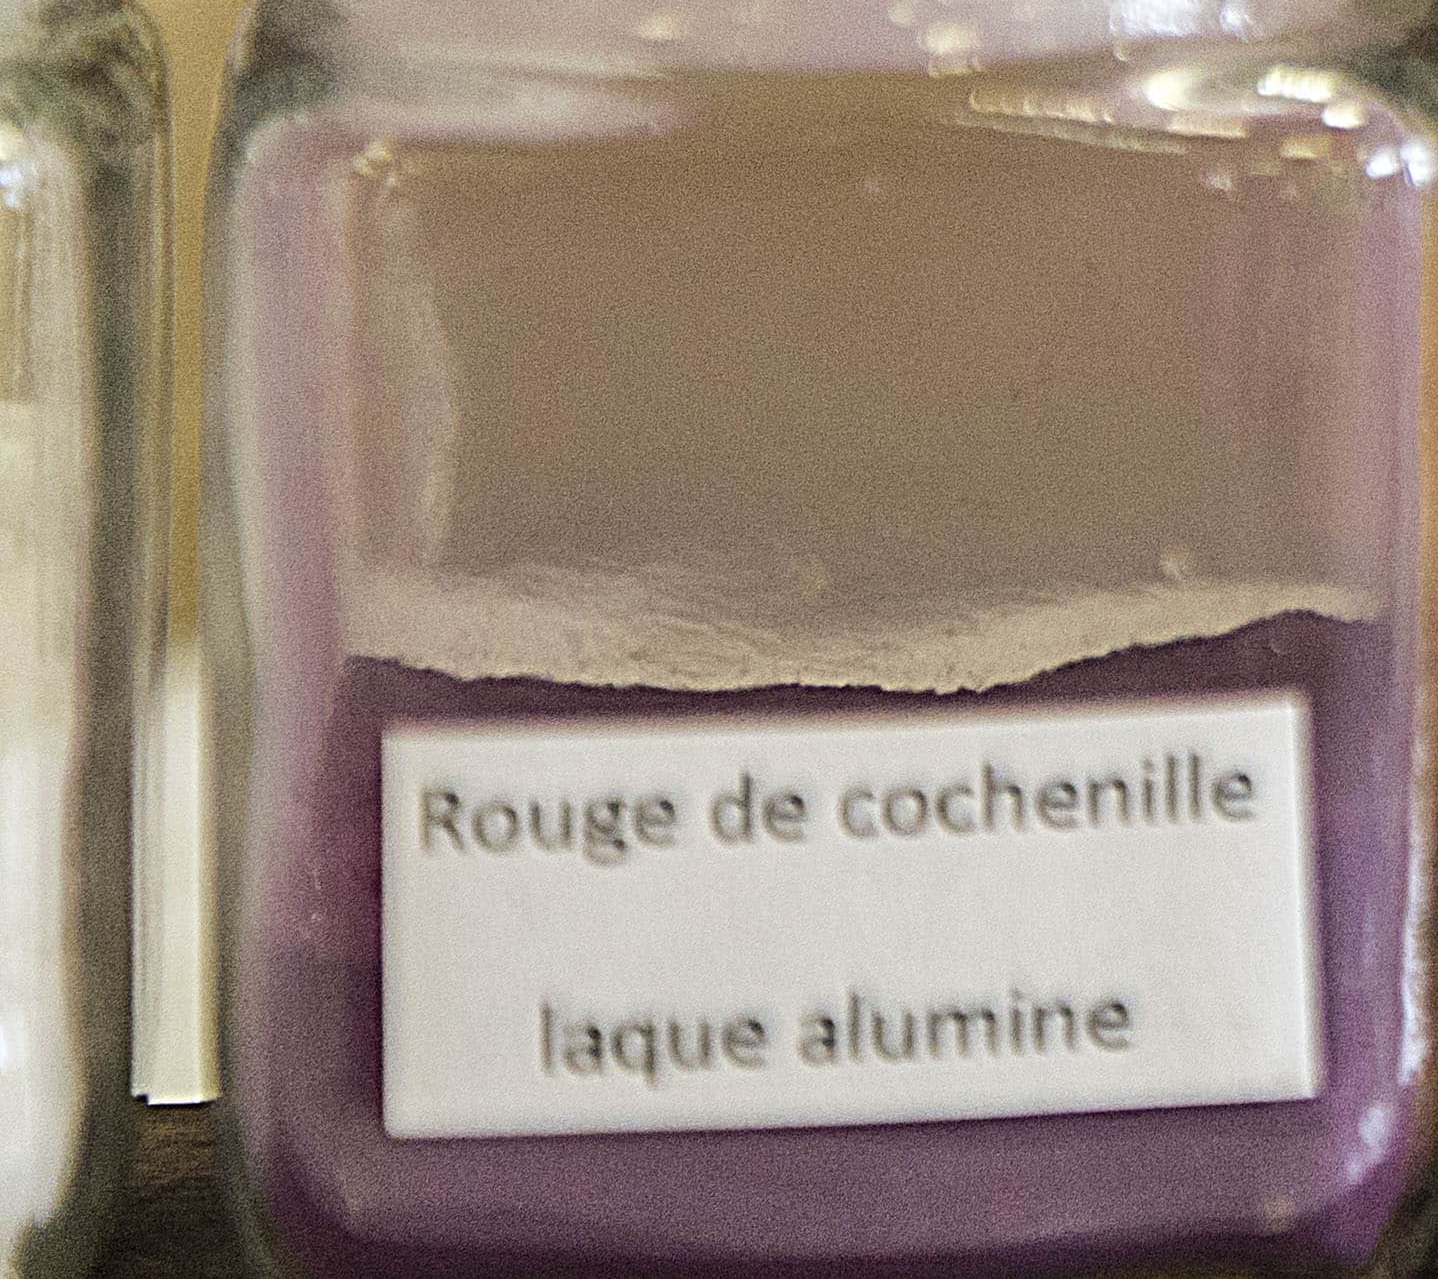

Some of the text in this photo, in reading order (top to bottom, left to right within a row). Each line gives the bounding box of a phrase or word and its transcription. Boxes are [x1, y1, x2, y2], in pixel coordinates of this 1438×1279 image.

[417, 753, 1257, 867] Rouge de cochenille
[538, 987, 1134, 1086] laque alumine
